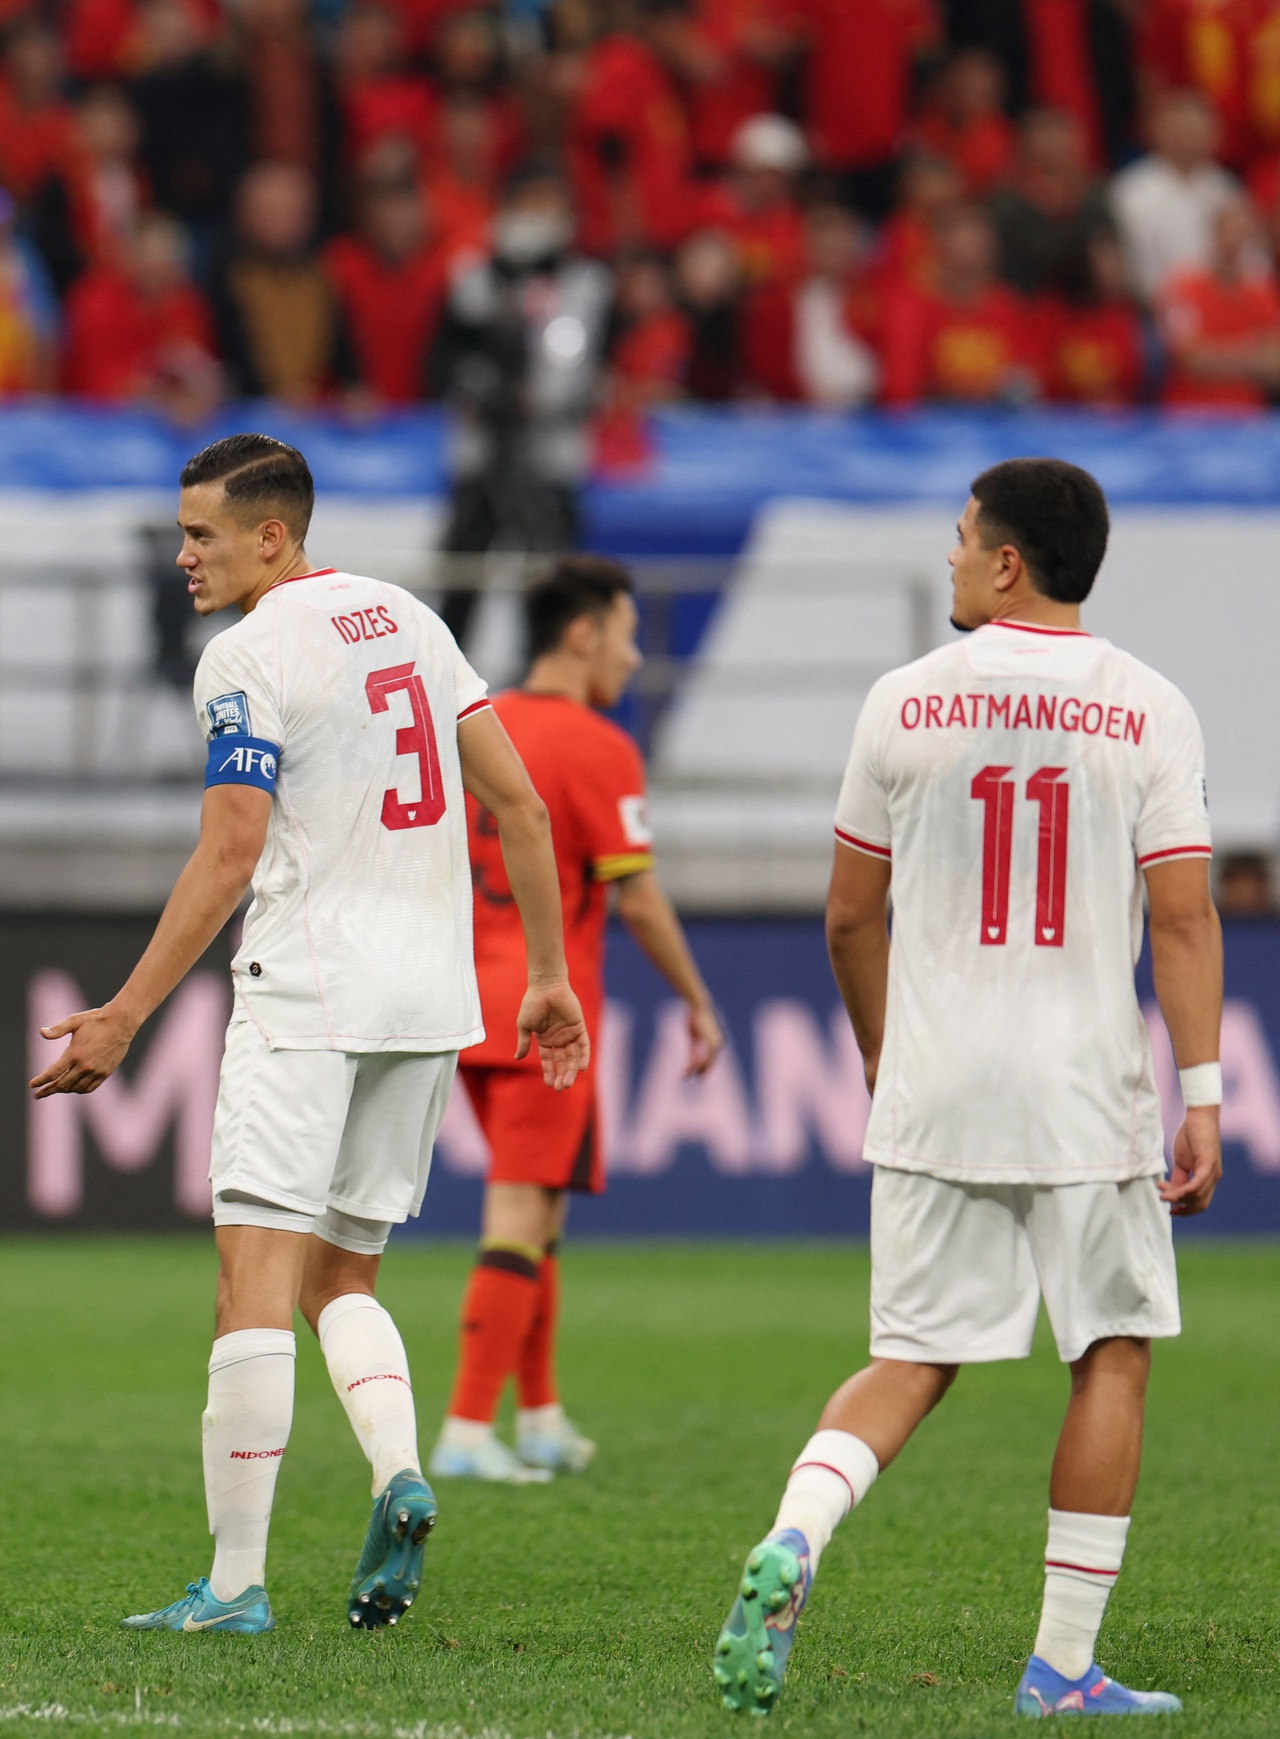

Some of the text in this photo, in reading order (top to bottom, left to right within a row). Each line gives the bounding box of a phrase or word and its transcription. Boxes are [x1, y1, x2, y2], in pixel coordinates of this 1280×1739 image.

[330, 605, 398, 645] IDZES
[365, 661, 446, 831] 3
[901, 694, 1145, 746] ORATMANGOEN
[971, 766, 1069, 947] 11
